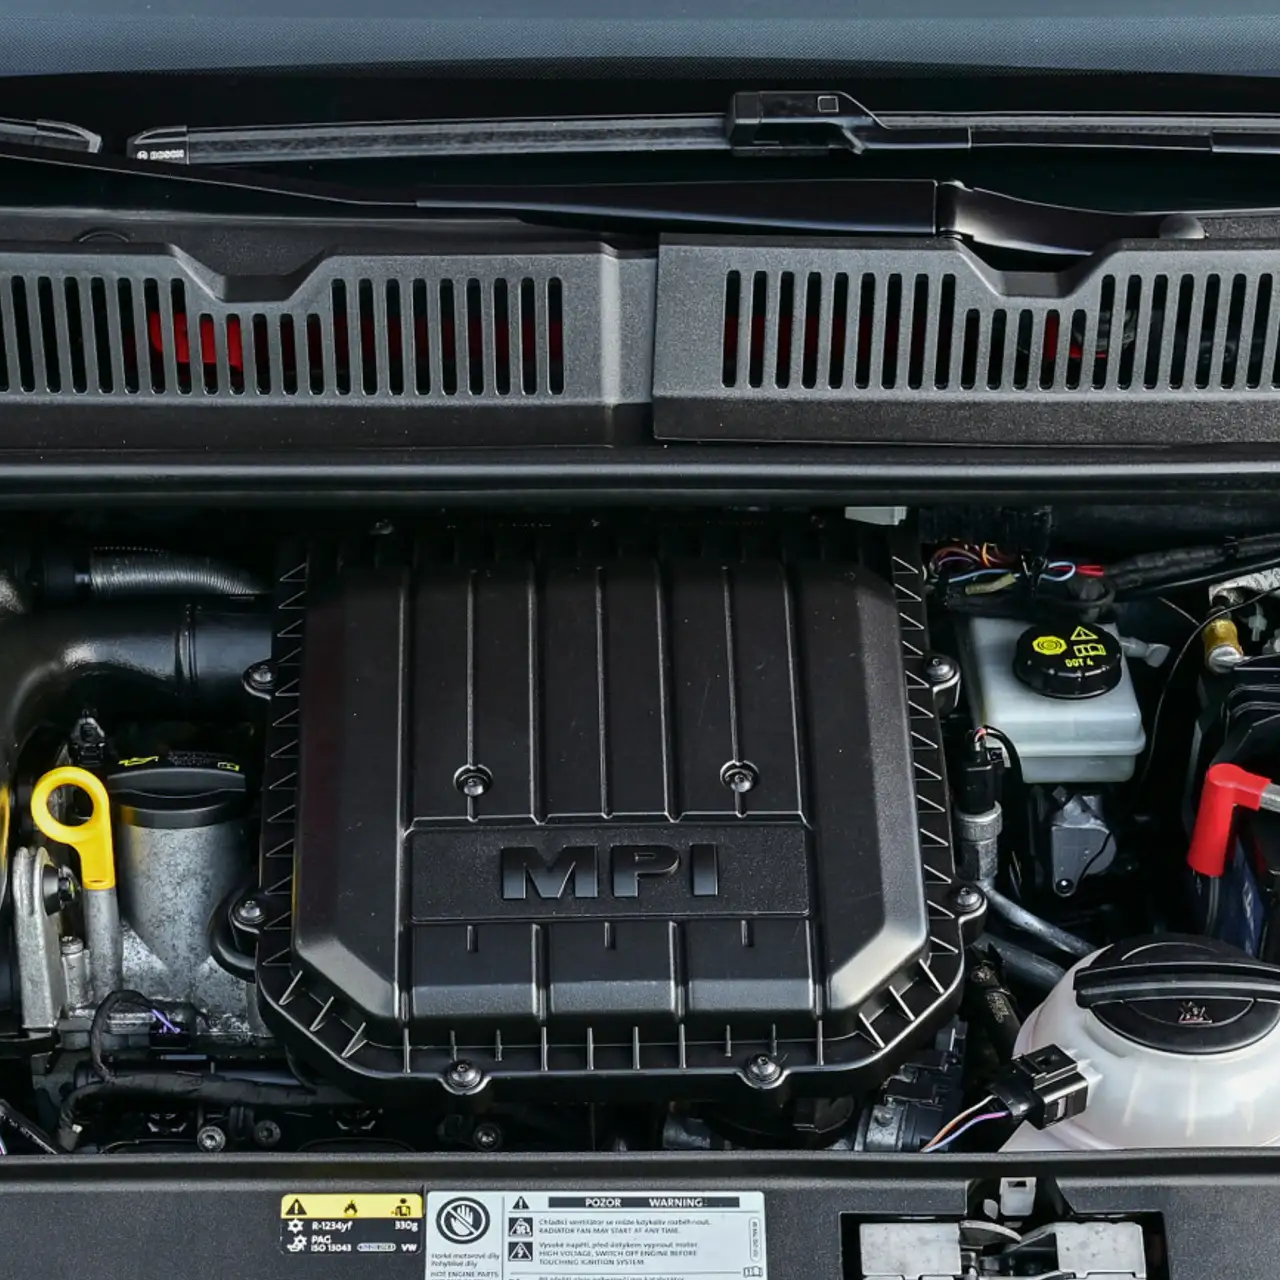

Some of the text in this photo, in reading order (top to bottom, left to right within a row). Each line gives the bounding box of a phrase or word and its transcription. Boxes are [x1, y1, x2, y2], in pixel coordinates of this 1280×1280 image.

[149, 149, 185, 160] BOSCH
[1065, 658, 1083, 668] DOT
[502, 842, 719, 899] MPI
[585, 1198, 703, 1208] POZOR WARNING
[311, 1221, 419, 1233] R-1234yf 330g
[311, 1235, 332, 1243] PAG
[310, 1243, 326, 1252] ISO
[401, 1243, 418, 1252] VW
